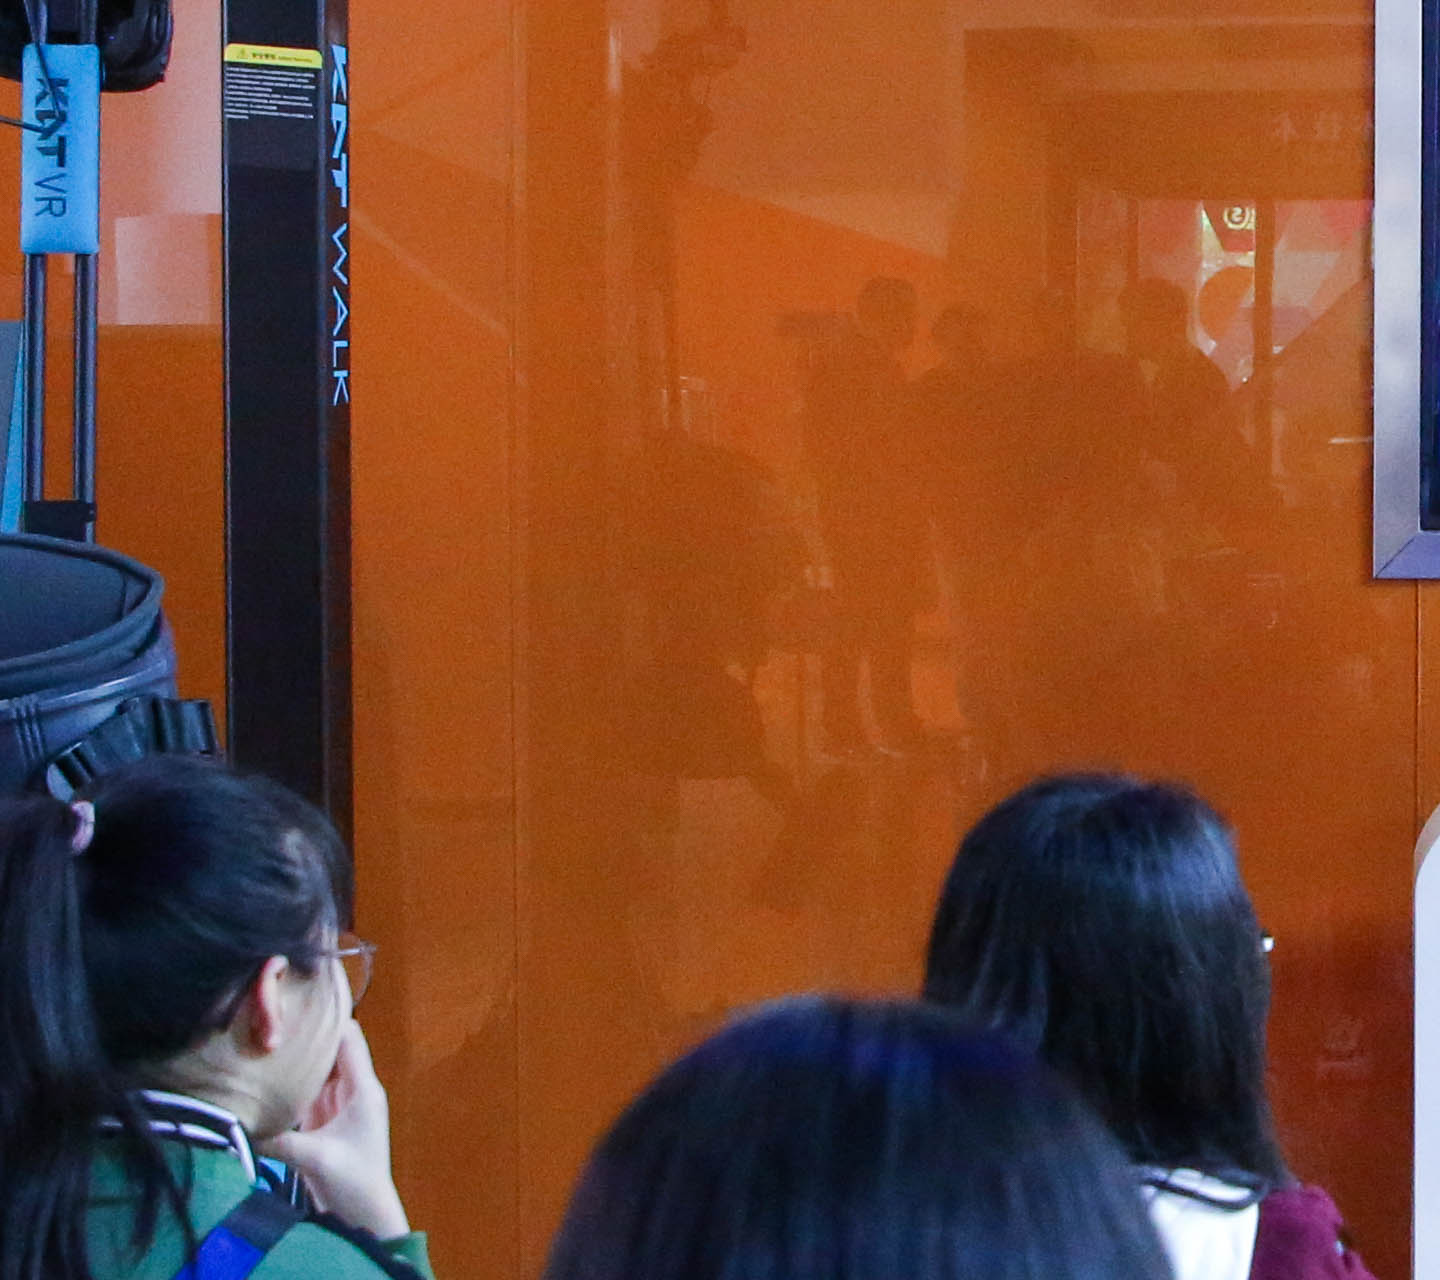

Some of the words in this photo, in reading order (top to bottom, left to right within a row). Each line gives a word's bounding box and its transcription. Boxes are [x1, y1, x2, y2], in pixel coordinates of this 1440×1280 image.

[33, 173, 67, 218] VR
[331, 44, 348, 208] KAT
[331, 223, 350, 406] WALK
